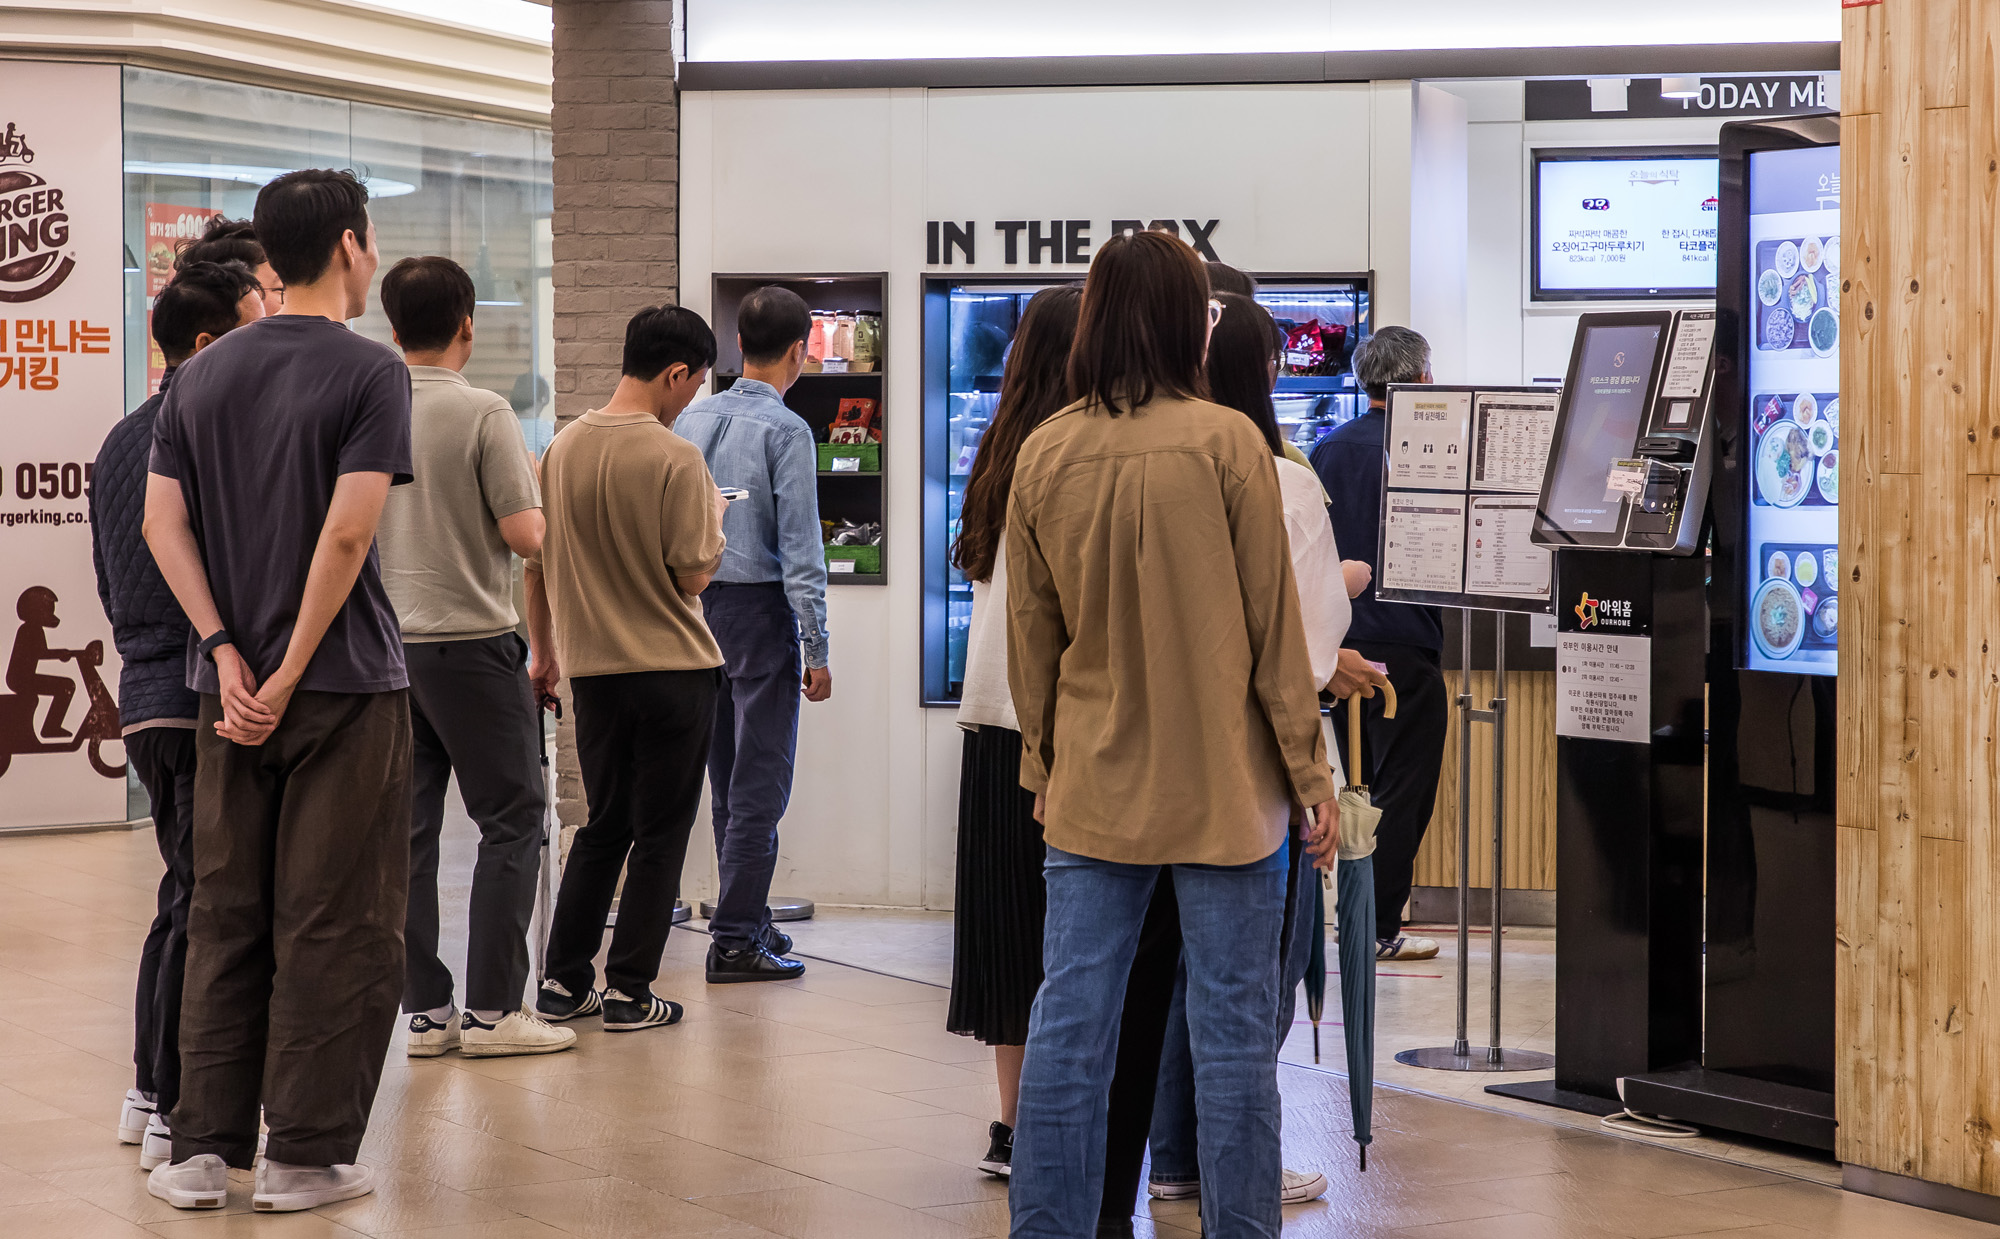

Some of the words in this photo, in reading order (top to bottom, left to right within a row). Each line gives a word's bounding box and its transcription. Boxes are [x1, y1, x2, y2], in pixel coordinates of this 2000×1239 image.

[1603, 229, 1628, 239] 매콤한
[1661, 229, 1670, 239] 한
[1672, 229, 1691, 239] 접시,
[926, 220, 975, 265] IN
[995, 220, 1091, 265] THE
[1552, 240, 1645, 252] 오징어고구마두루치기
[1569, 254, 1596, 262] 823kcal
[1600, 254, 1626, 263] 7,000원
[1682, 254, 1710, 262] 841kcal
[16, 319, 111, 354] 만나는
[1, 509, 92, 527] rgerking.co.
[1600, 599, 1632, 618] 아워홈
[1600, 618, 1631, 627] OURHOME
[1562, 641, 1579, 651] 외부인
[1580, 642, 1605, 653] 이용시간
[1606, 644, 1619, 654] 안내
